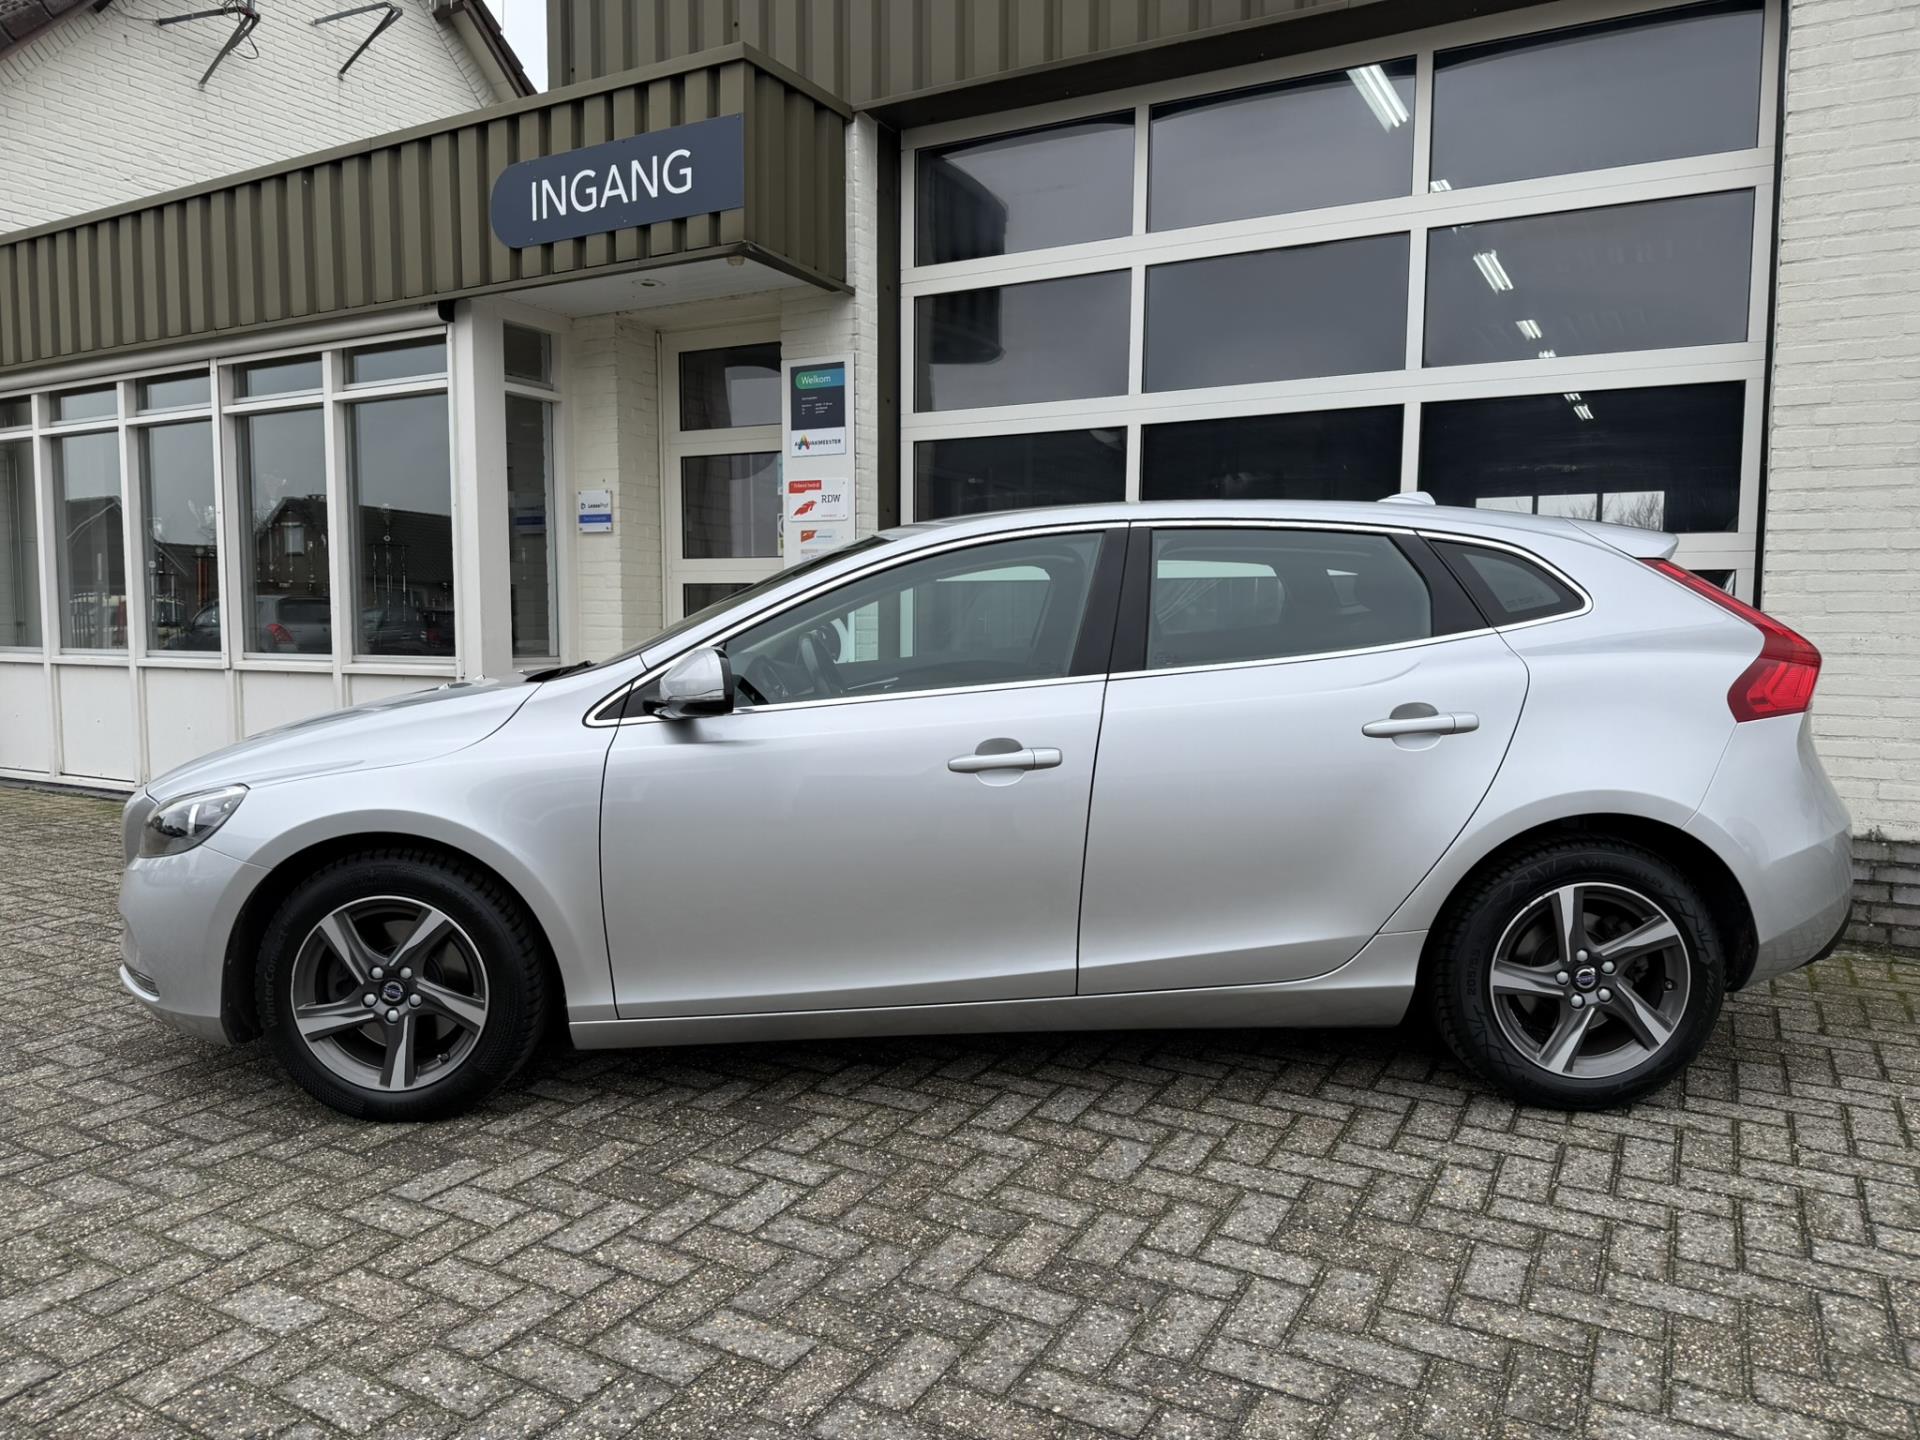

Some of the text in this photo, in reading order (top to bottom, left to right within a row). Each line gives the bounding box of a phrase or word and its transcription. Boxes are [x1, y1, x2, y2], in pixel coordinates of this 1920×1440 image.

[531, 149, 692, 221] INGANG
[801, 375, 831, 384] Welkom
[821, 494, 841, 504] RDW
